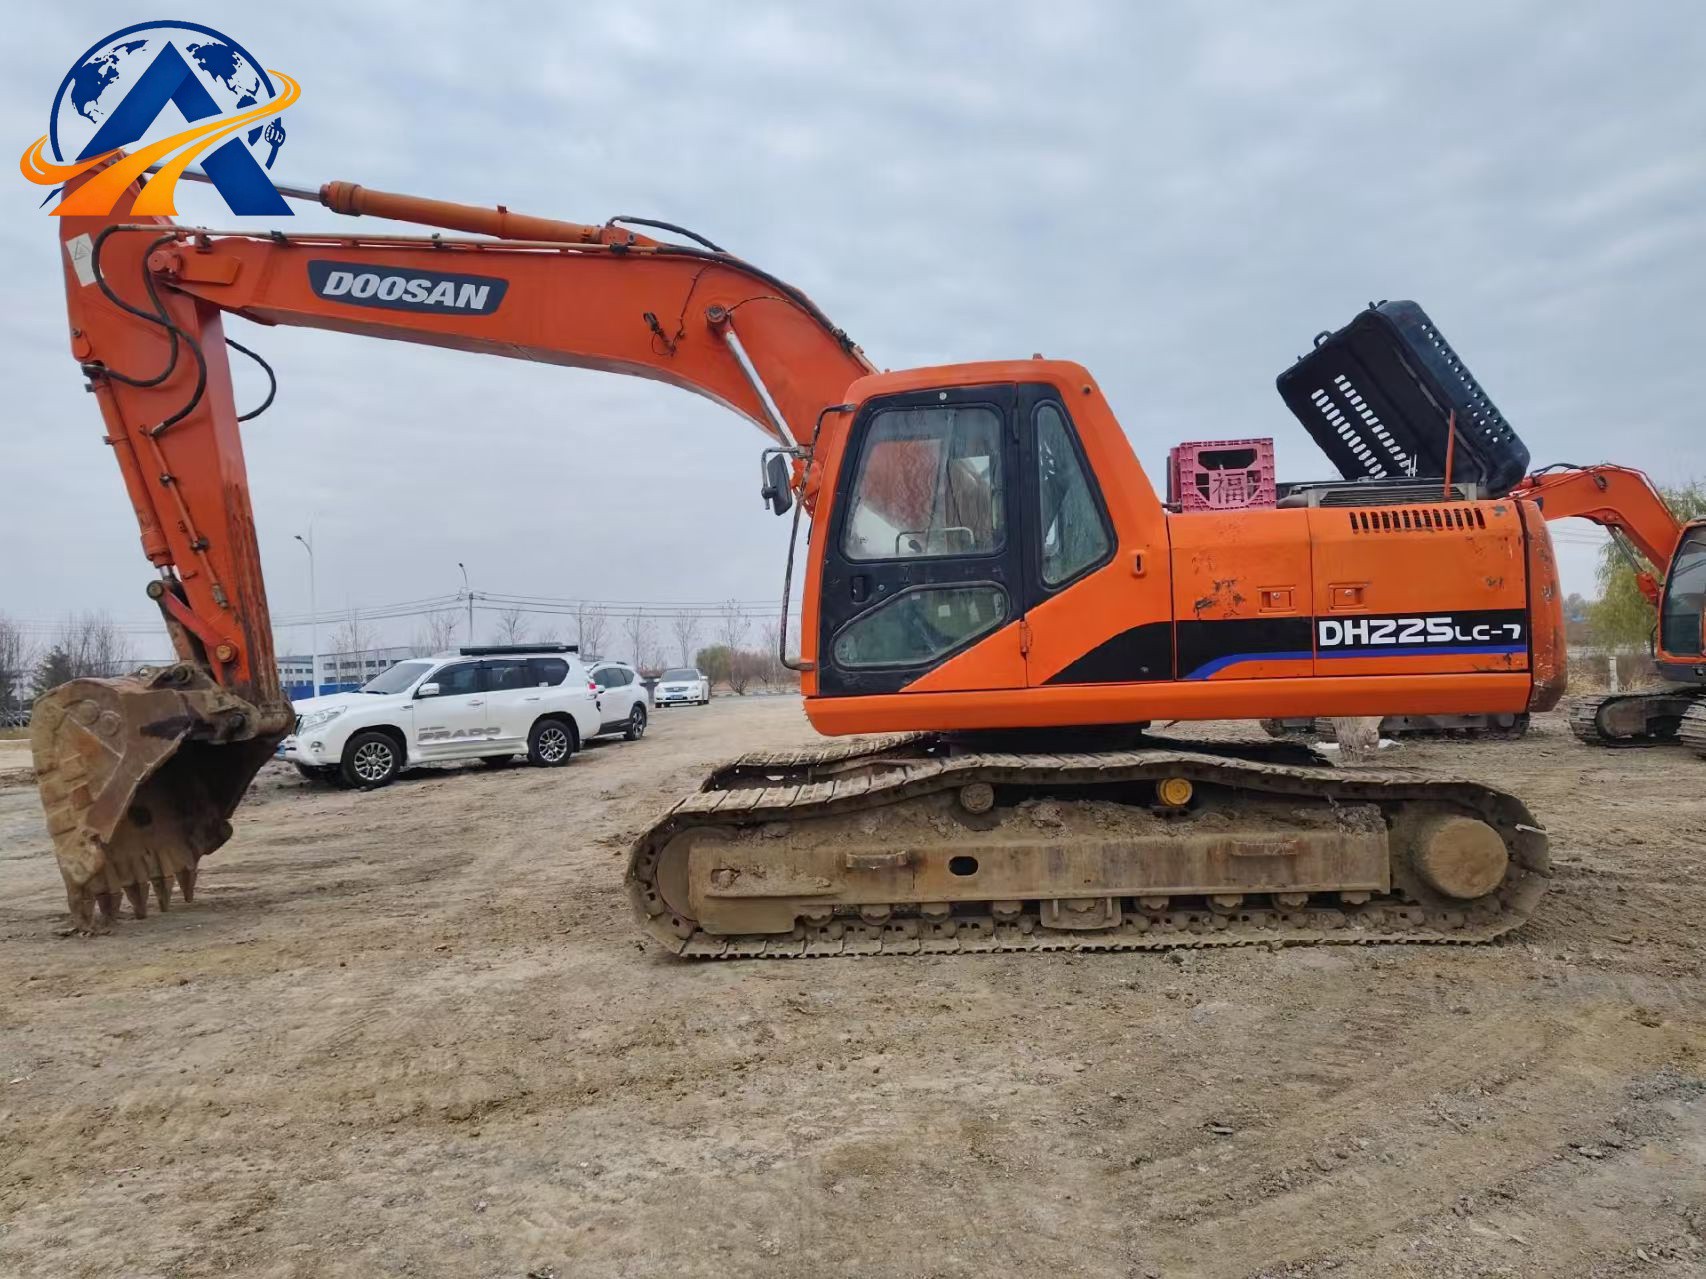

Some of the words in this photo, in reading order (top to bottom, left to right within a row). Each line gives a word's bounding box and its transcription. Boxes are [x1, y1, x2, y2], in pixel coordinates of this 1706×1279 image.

[322, 271, 490, 310] DOOSAN
[1212, 471, 1246, 504] 福
[1318, 616, 1522, 646] DH225LC-7
